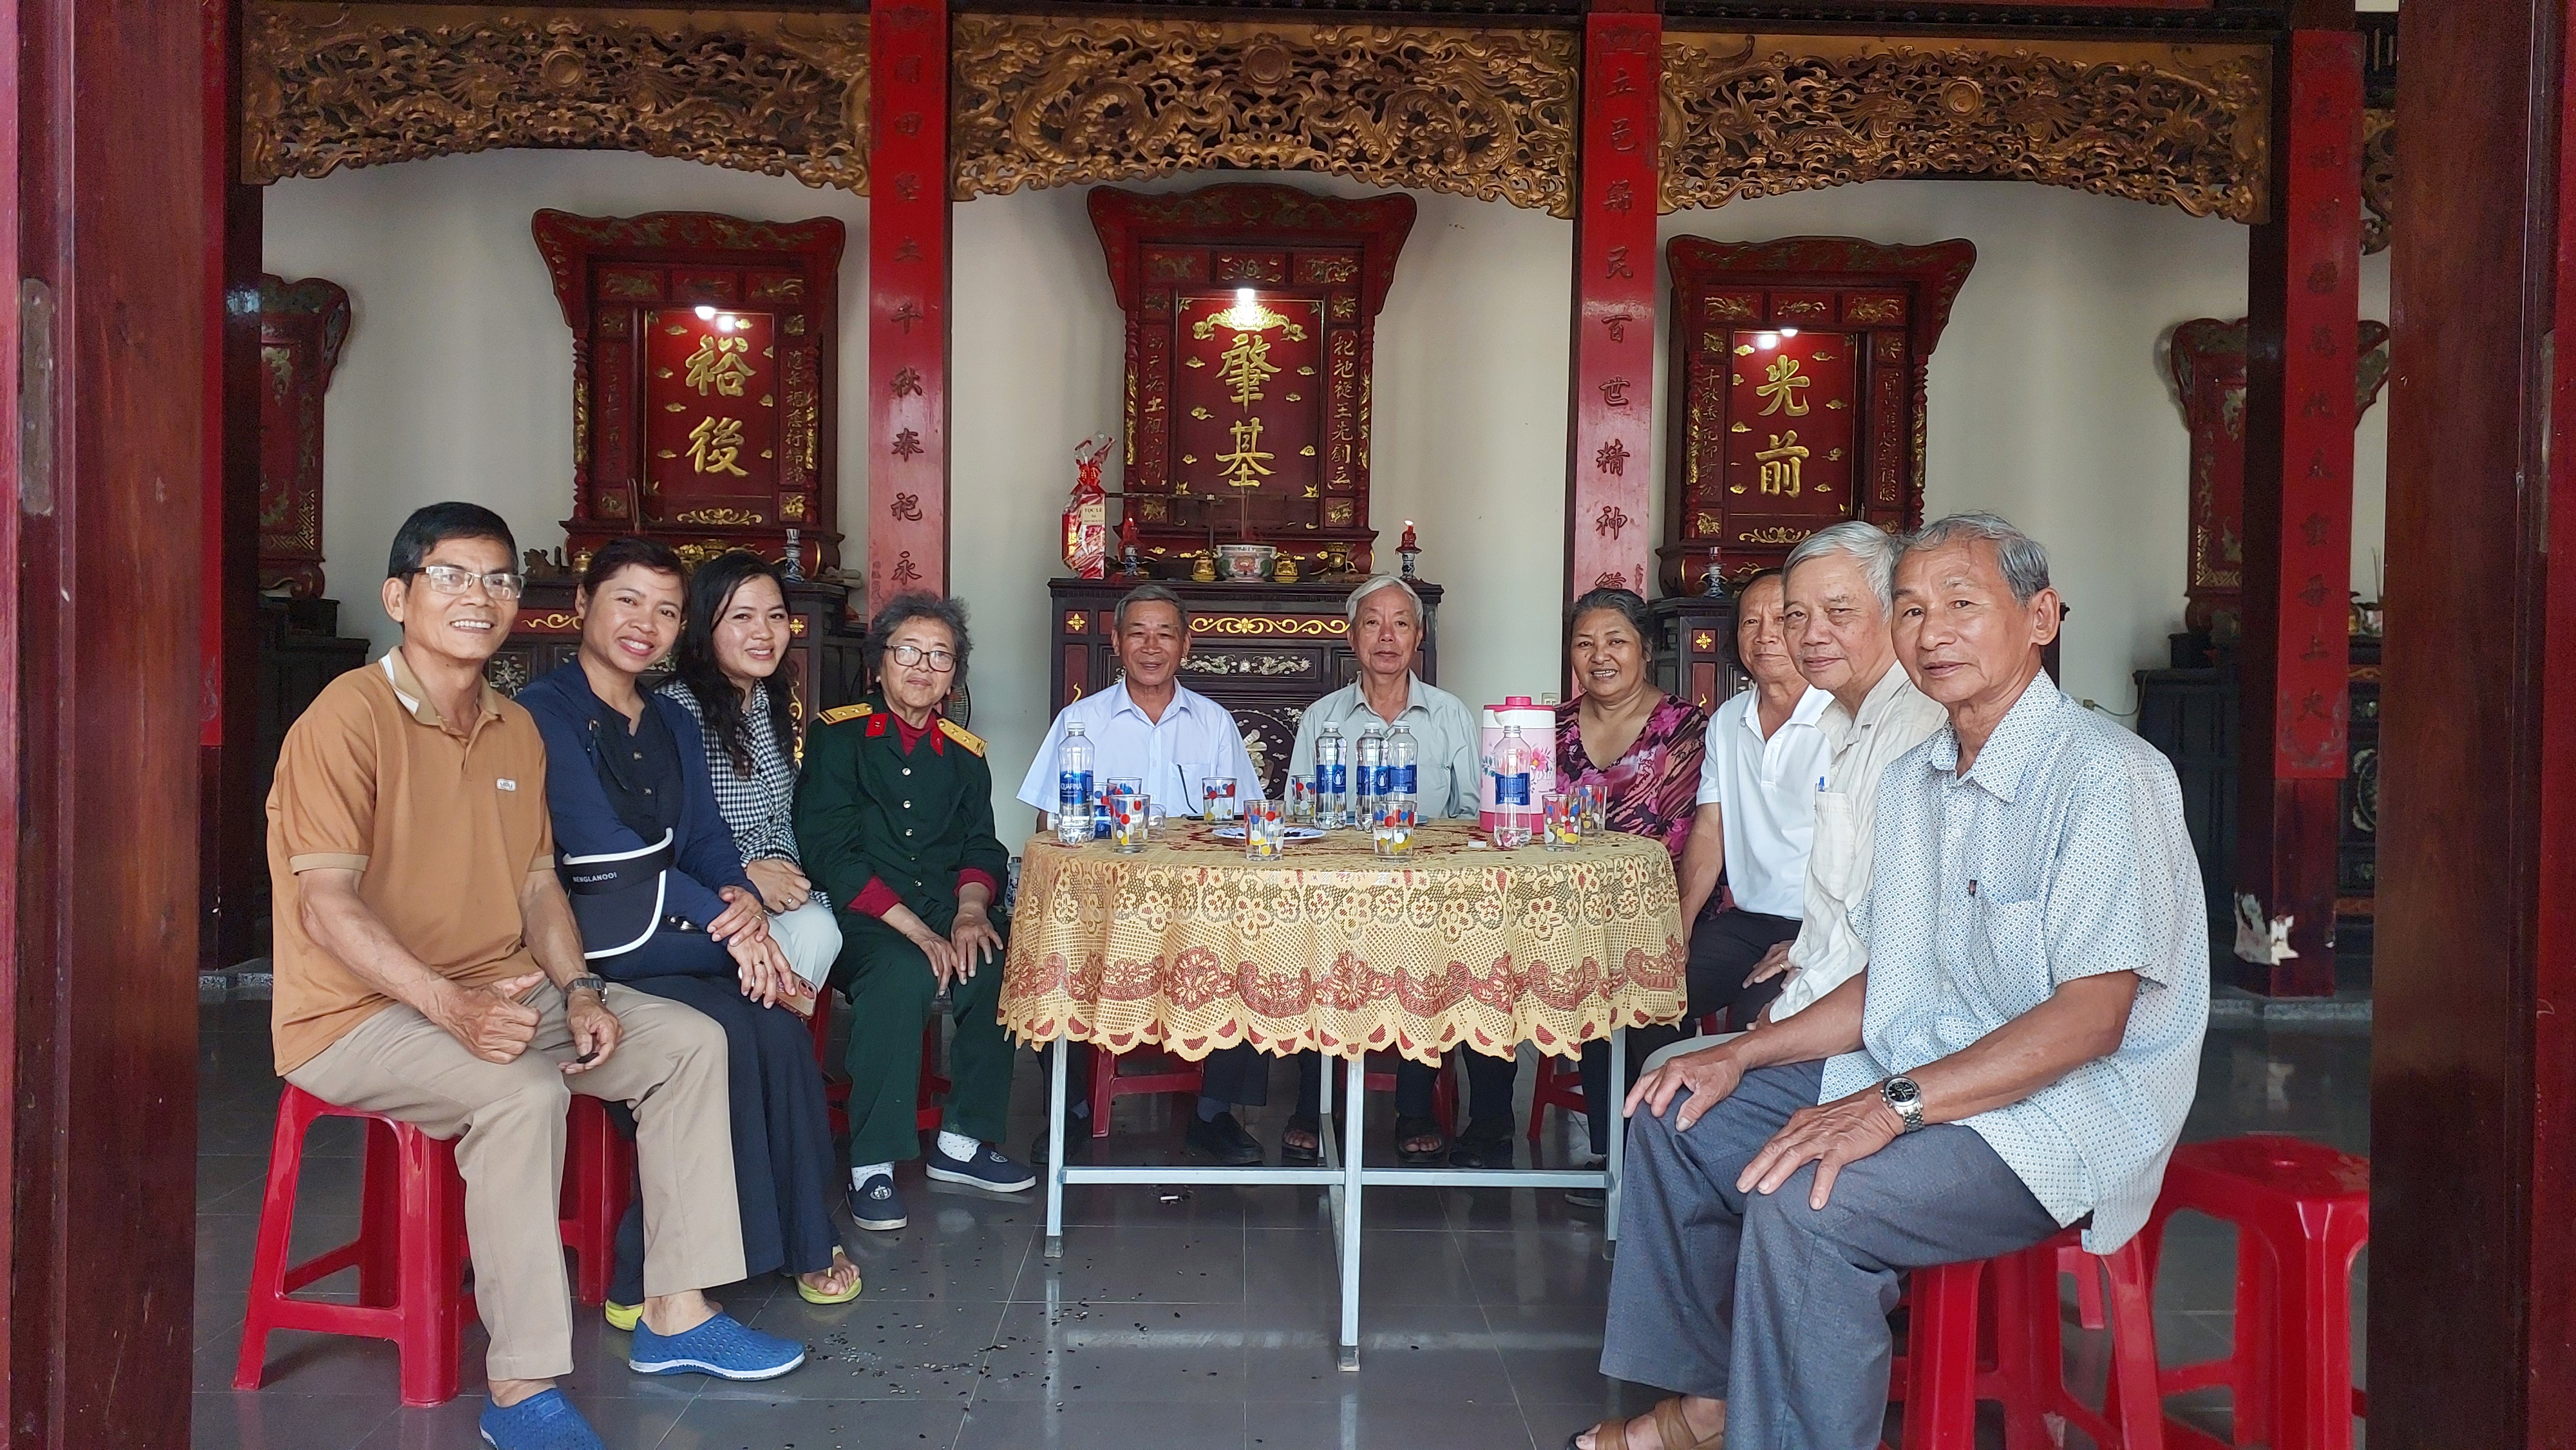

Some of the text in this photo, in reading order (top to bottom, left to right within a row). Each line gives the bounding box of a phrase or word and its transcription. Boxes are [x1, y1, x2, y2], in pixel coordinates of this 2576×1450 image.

[685, 334, 757, 477] 裕後
[1215, 333, 1282, 488] 肇基
[1755, 353, 1811, 498] 光前
